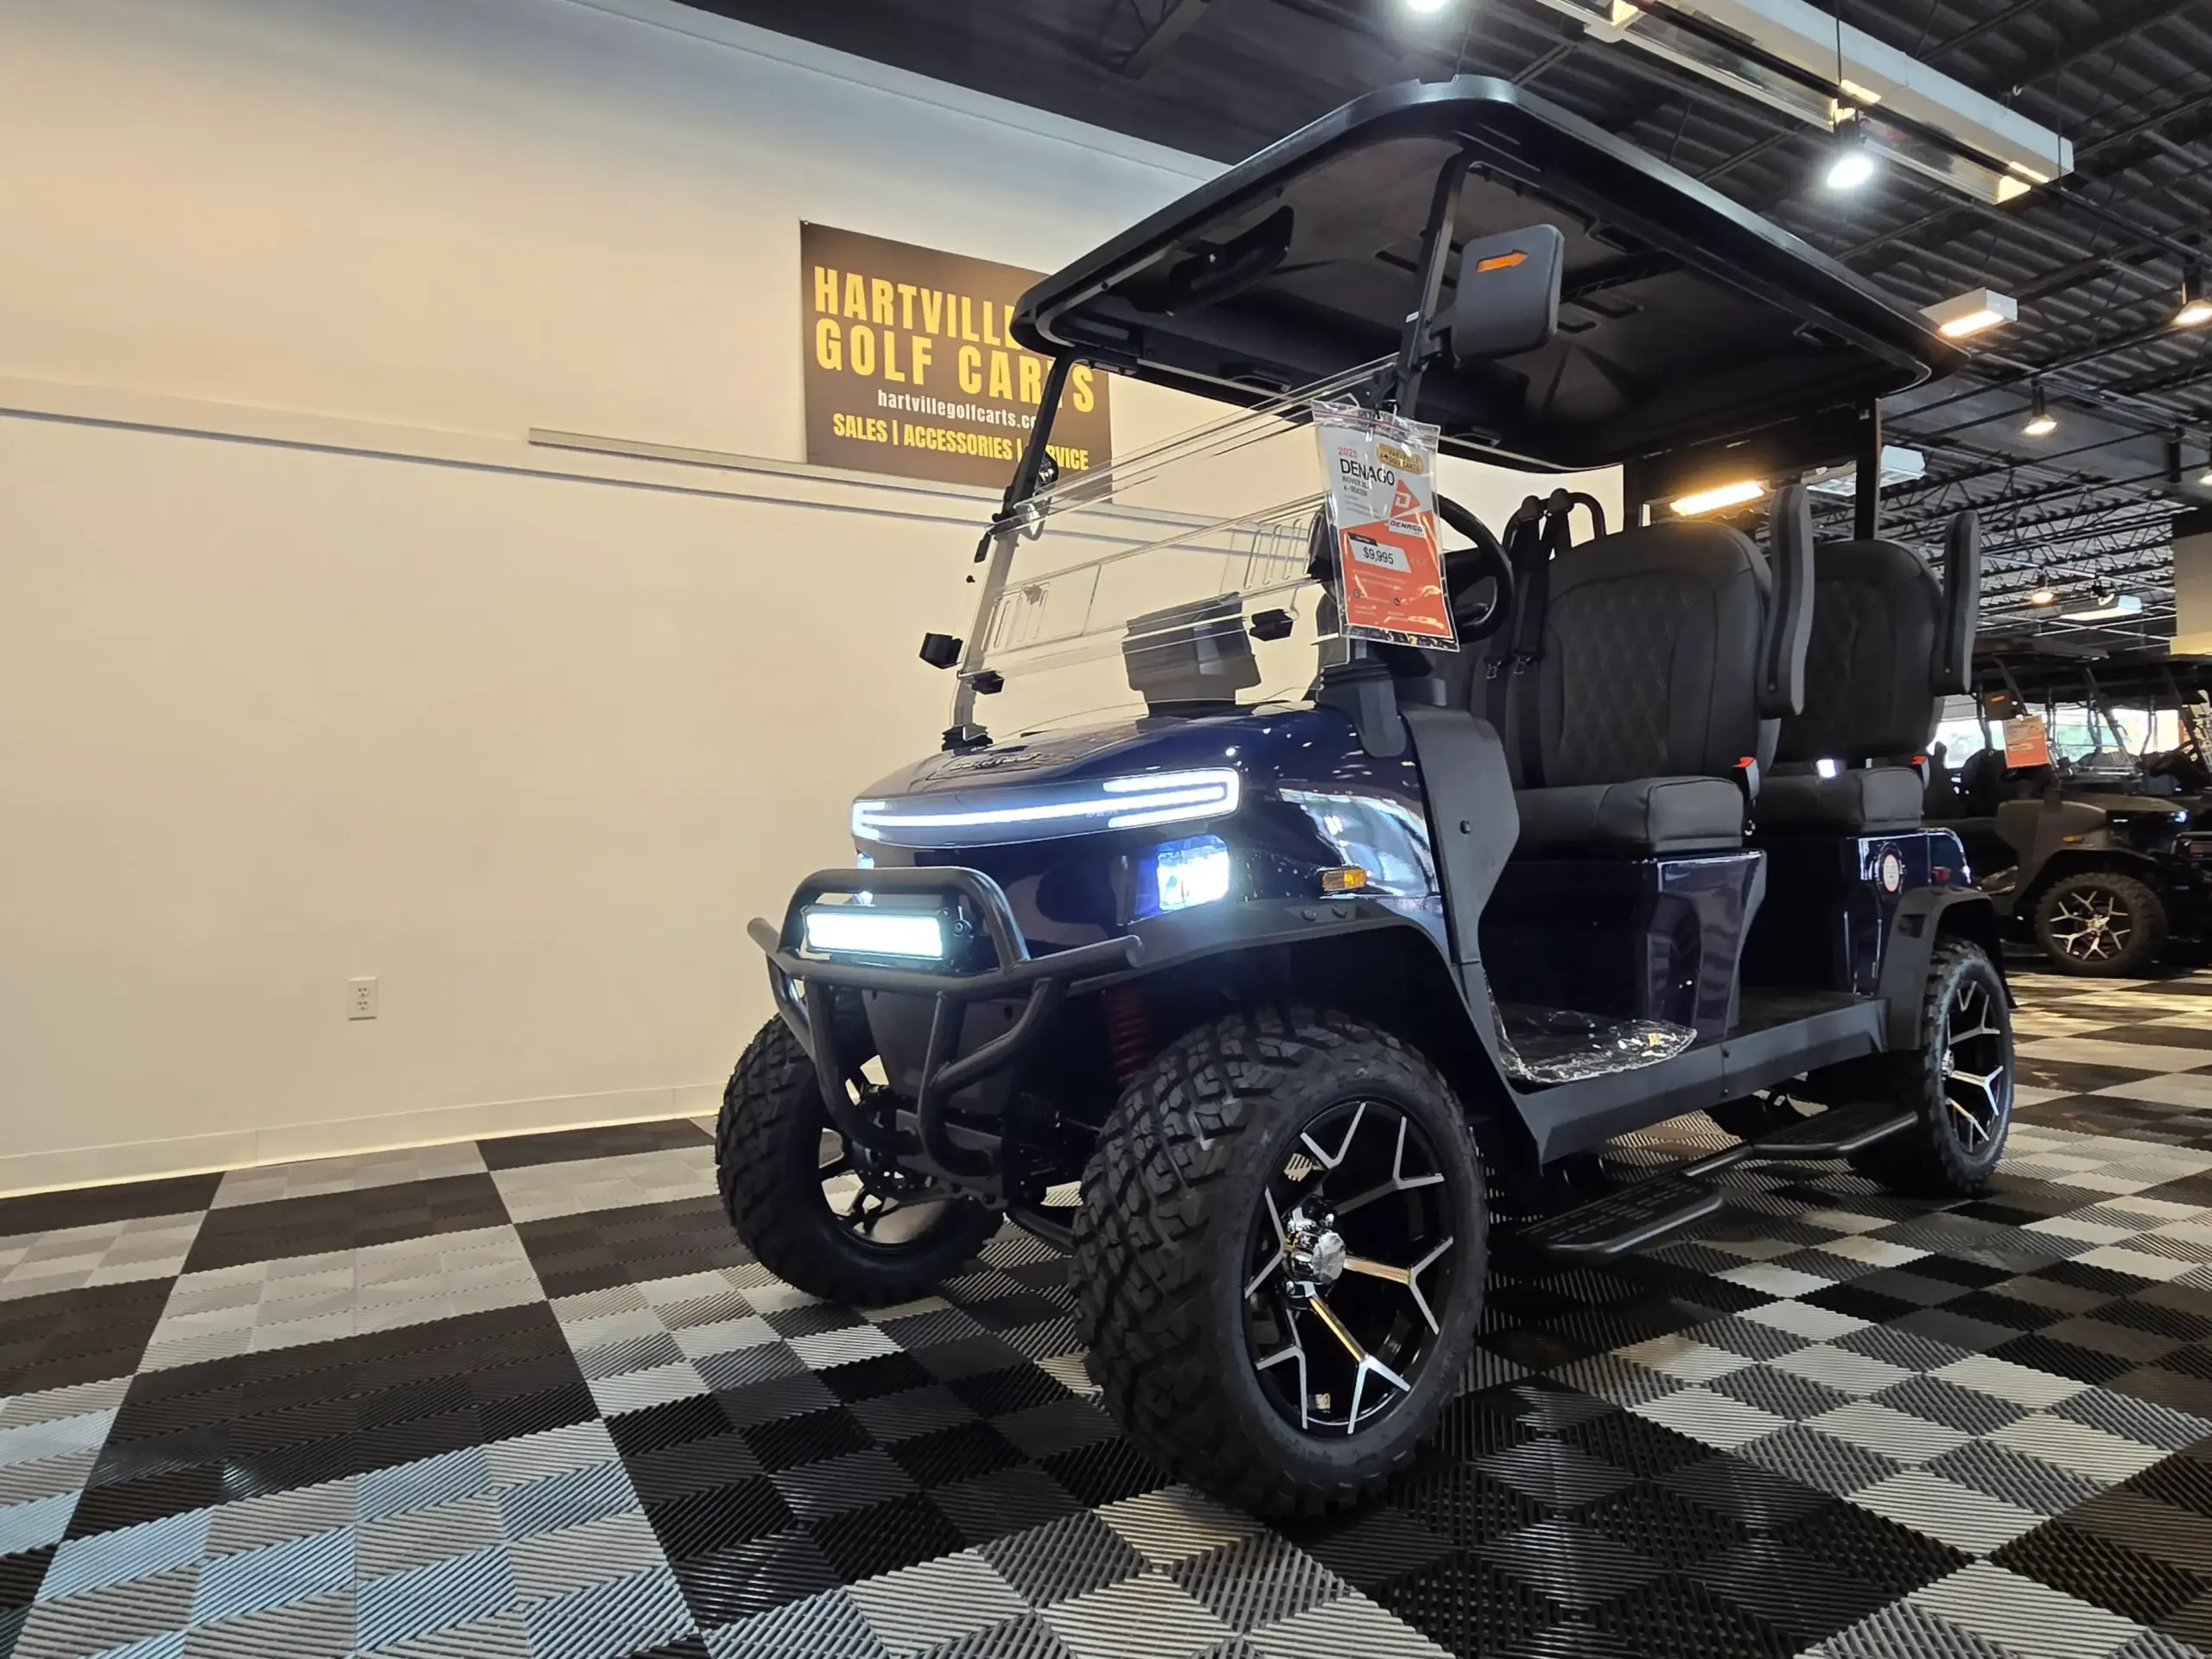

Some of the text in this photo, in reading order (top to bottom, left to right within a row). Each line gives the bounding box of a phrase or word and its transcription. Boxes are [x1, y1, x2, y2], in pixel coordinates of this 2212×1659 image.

[816, 318, 1095, 413] GOLF CARS
[877, 389, 1038, 429] hartvillegolfcarts.c
[832, 413, 888, 442] SALES
[904, 423, 1014, 461] ACCESSORIES
[1046, 444, 1090, 471] RVICE
[1340, 458, 1395, 486] DENAGO
[1363, 546, 1394, 565] $9,995
